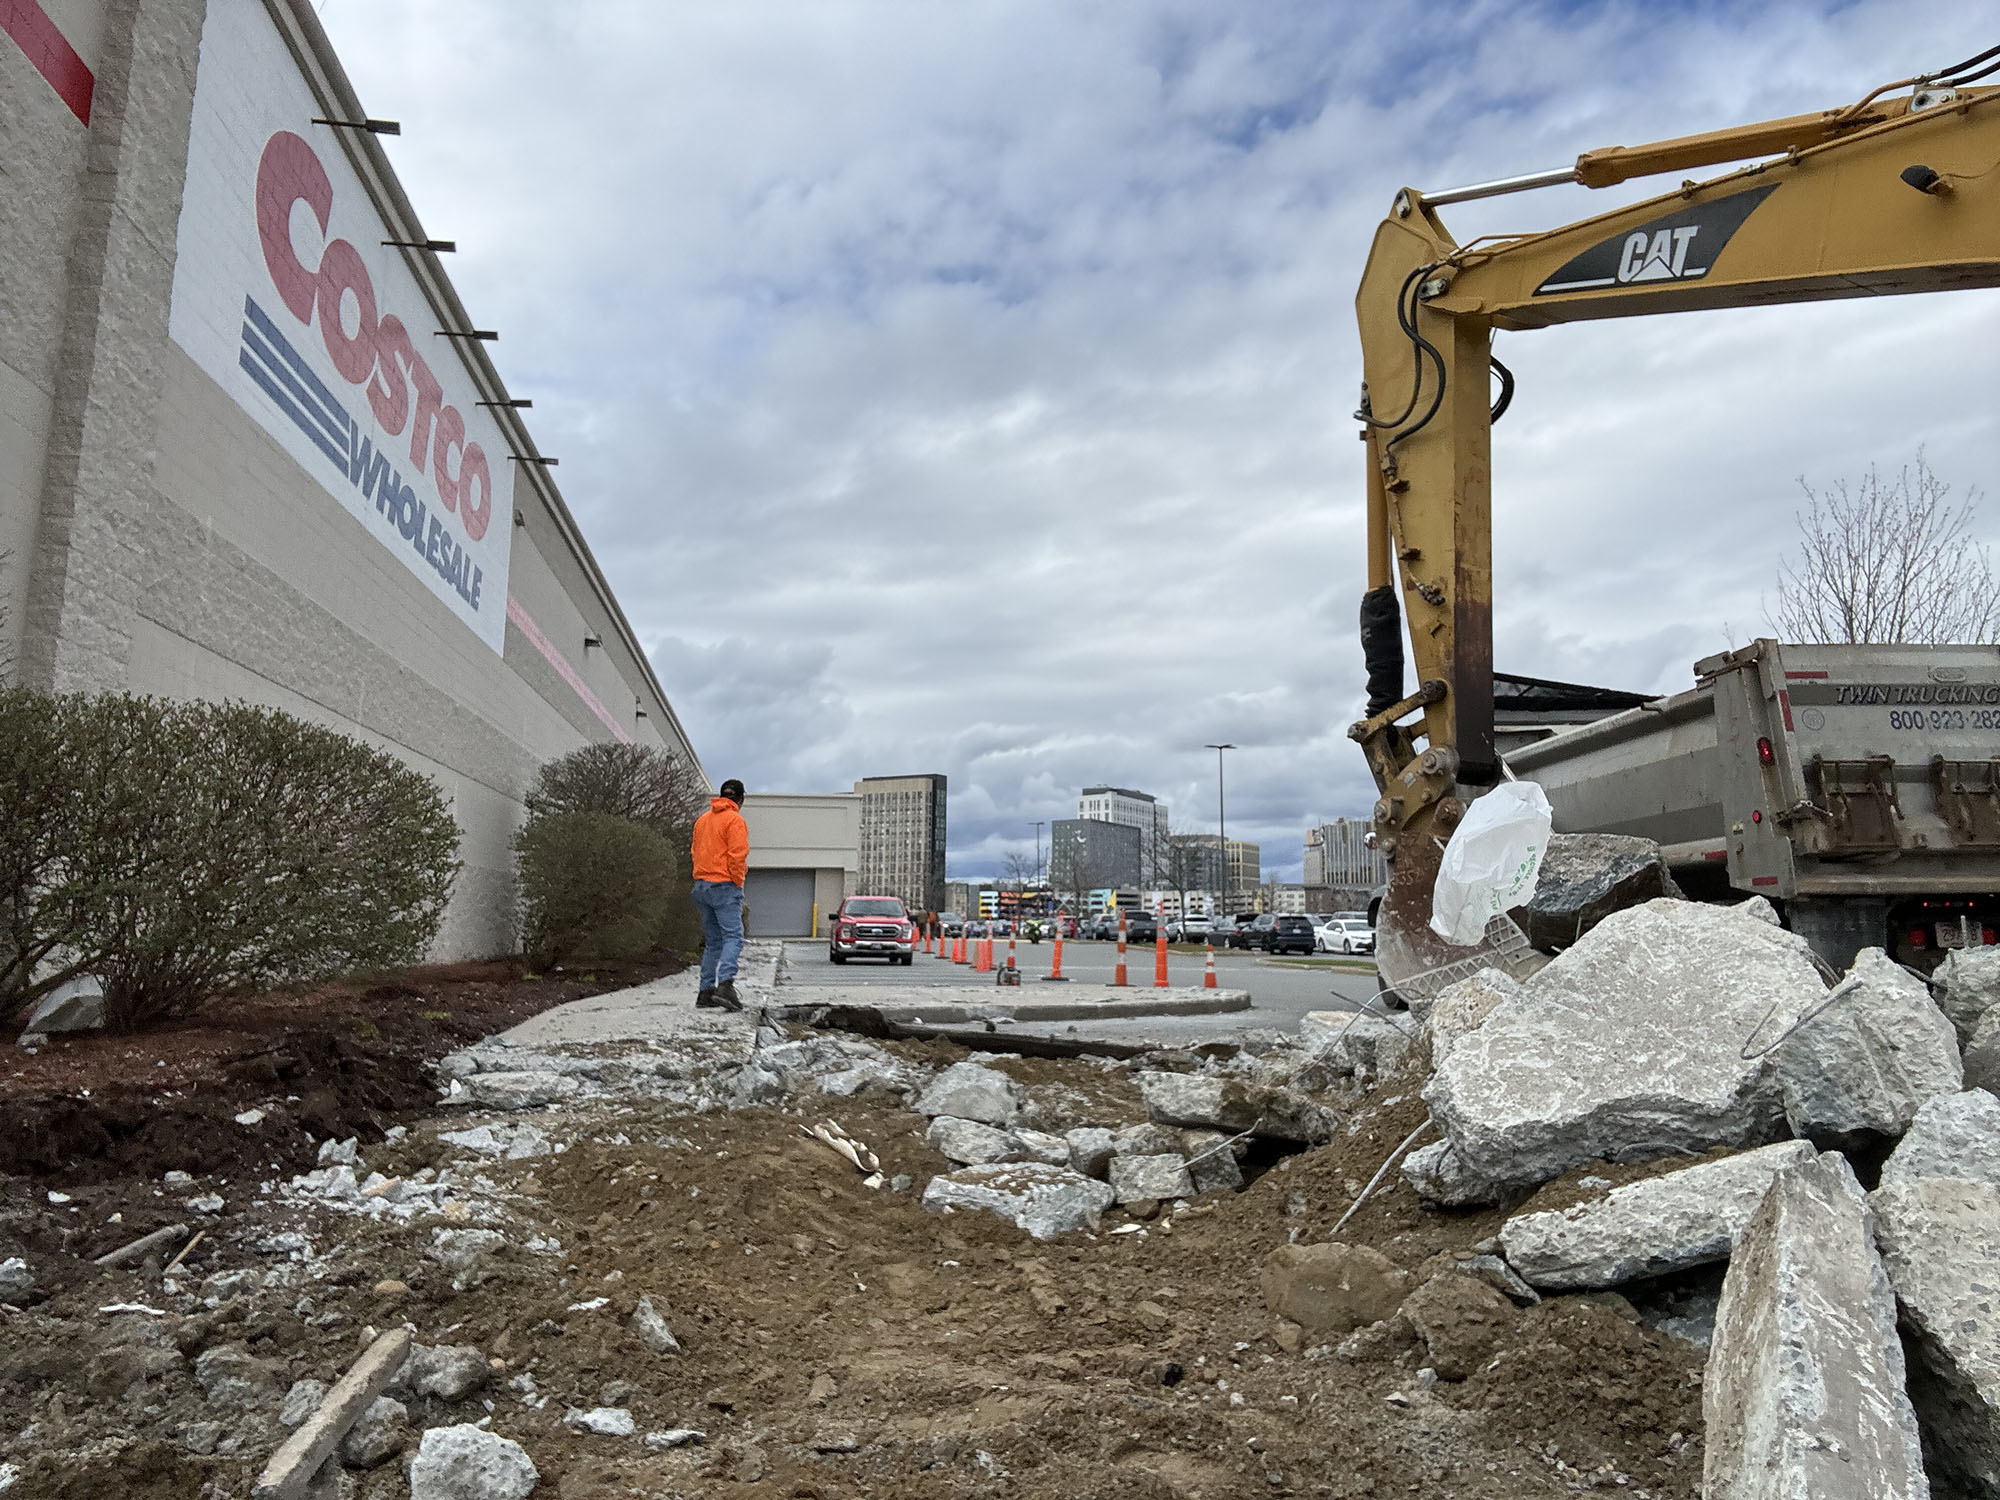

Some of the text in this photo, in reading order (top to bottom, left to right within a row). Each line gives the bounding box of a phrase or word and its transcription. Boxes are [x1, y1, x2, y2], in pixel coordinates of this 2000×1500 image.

[1617, 224, 1700, 283] CAT
[255, 130, 491, 542] COSTCO
[349, 418, 483, 611] WHOLESALE
[1836, 686, 2000, 705] TWIN TRUCKING
